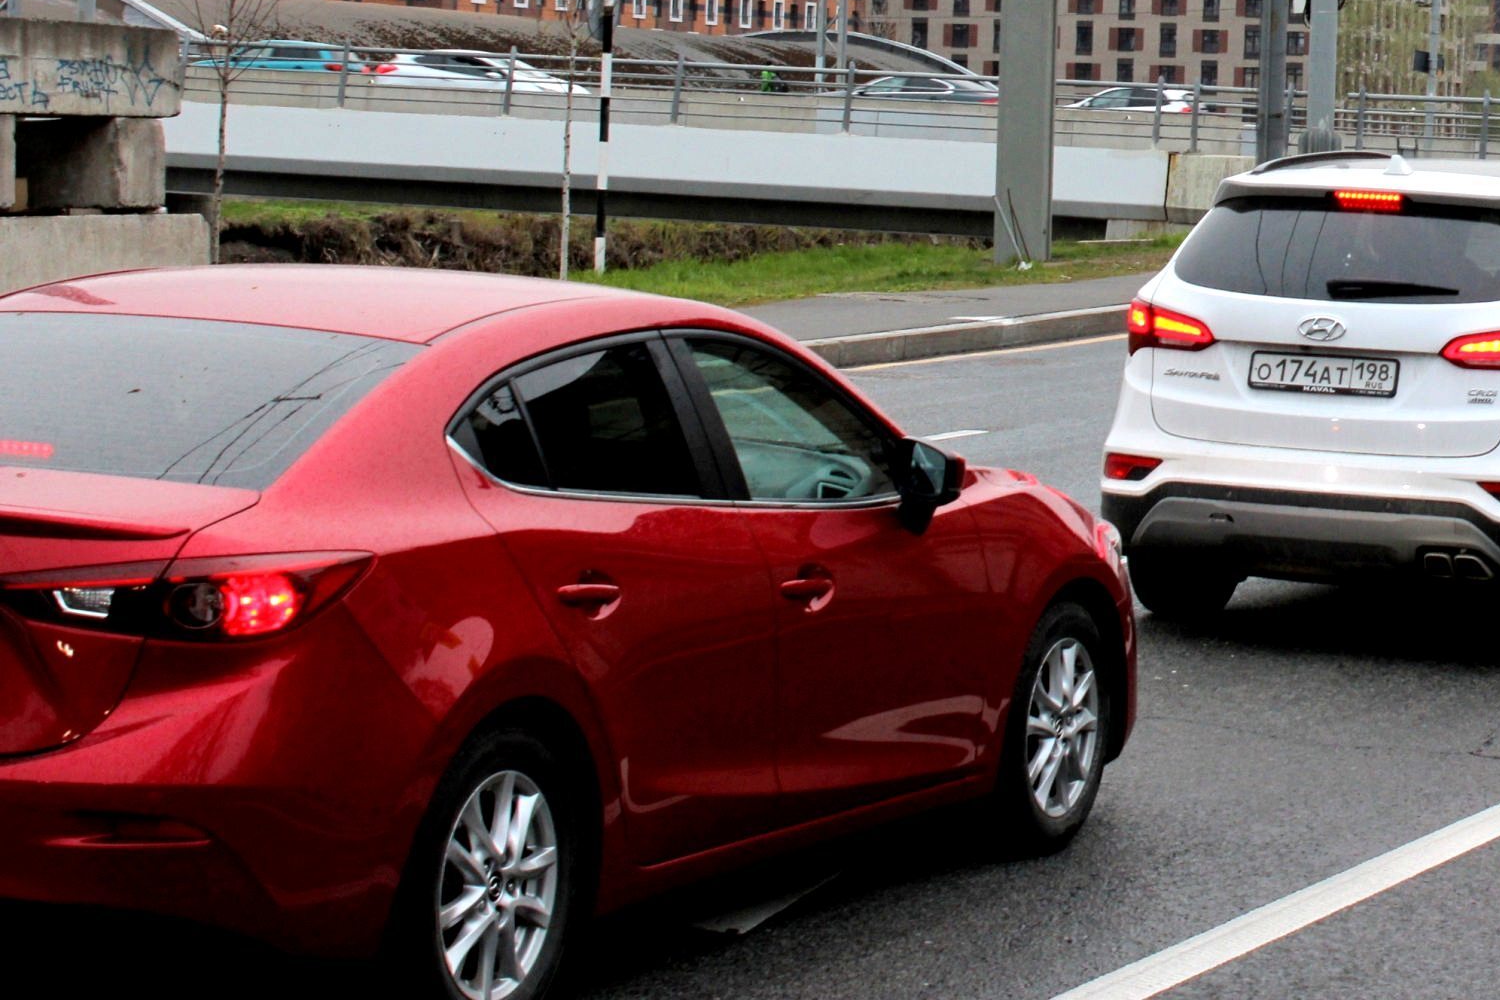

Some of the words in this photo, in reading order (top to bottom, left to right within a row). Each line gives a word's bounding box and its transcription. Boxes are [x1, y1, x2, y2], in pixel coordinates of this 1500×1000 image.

[1355, 362, 1389, 381] 198
[1302, 385, 1337, 394] HAVAL
[1365, 381, 1383, 390] RUS
